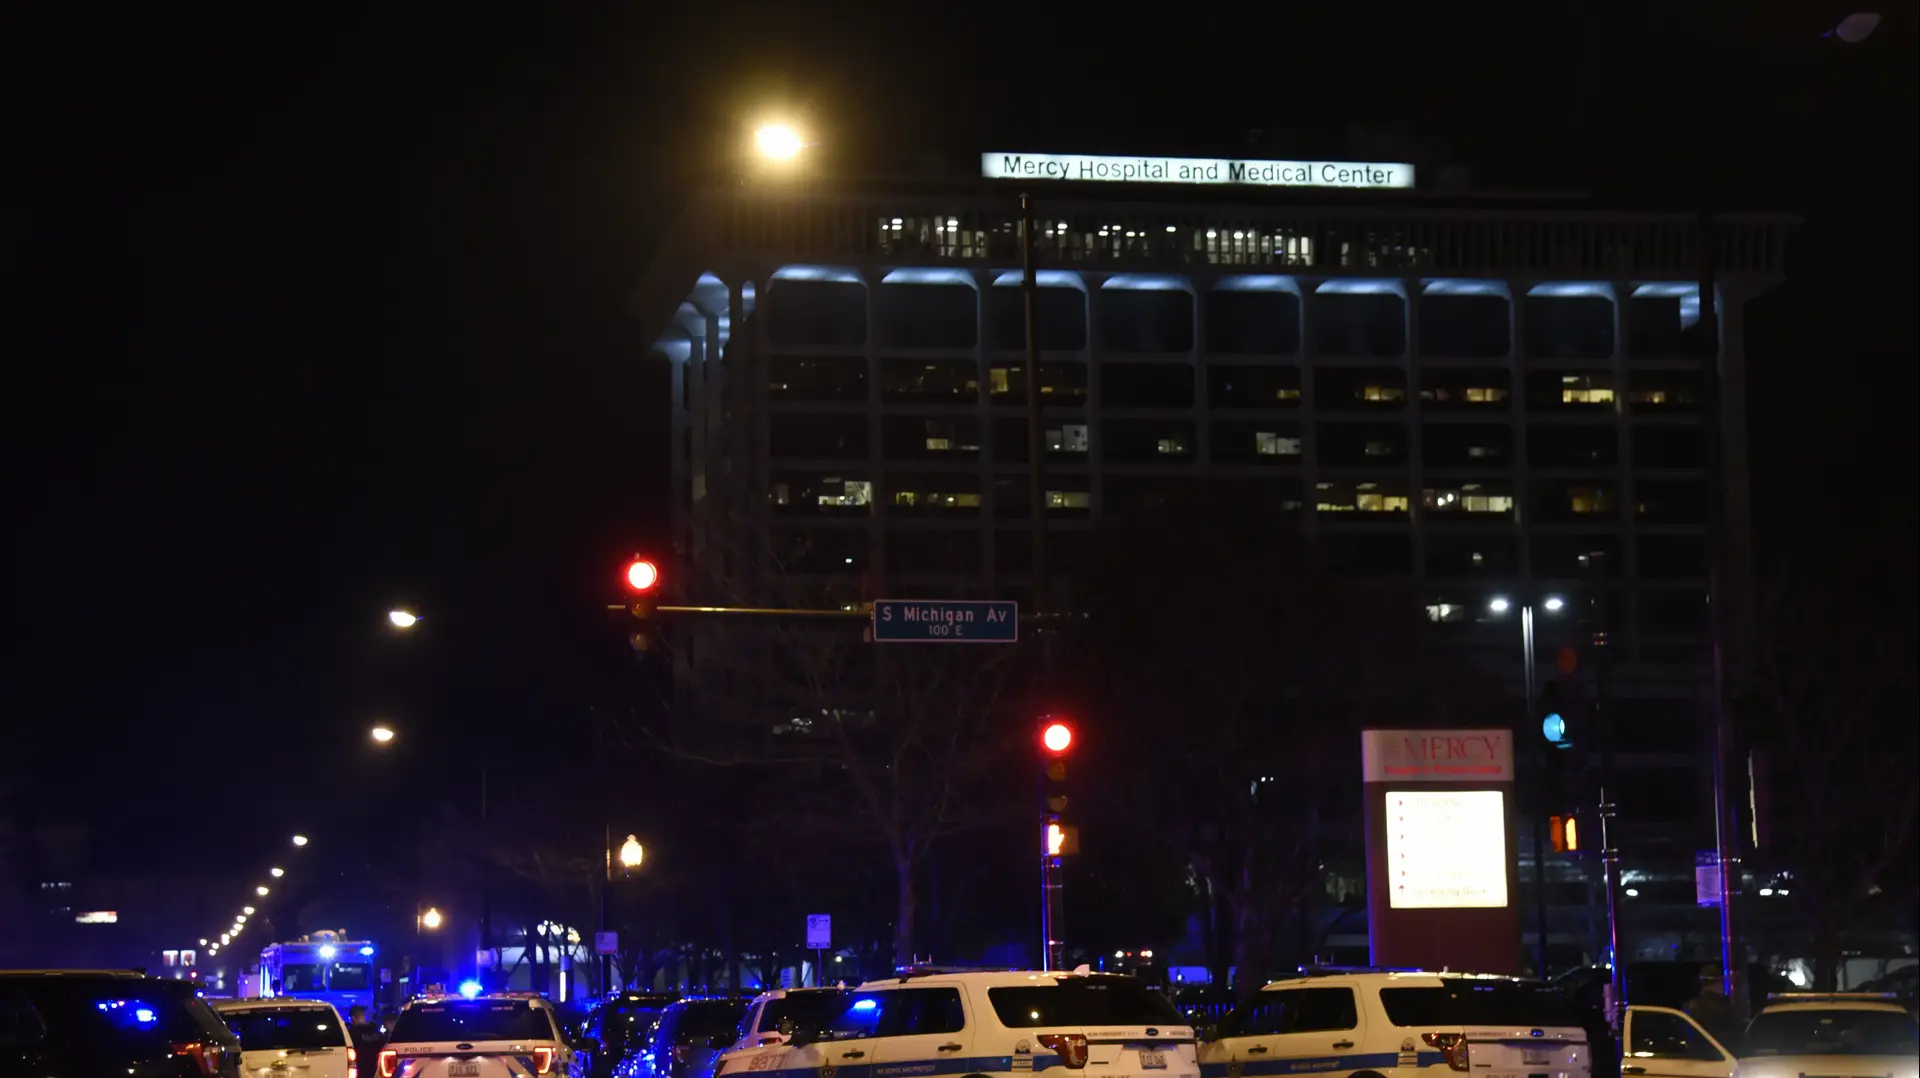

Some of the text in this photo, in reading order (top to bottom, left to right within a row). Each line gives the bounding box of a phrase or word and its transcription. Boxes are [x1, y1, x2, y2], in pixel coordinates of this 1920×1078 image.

[1003, 155, 1394, 184] Mercy Hospital and Medical Center
[882, 606, 1007, 626] S Michigan Av
[929, 625, 963, 636] 100 E
[1404, 736, 1500, 760] MERCY
